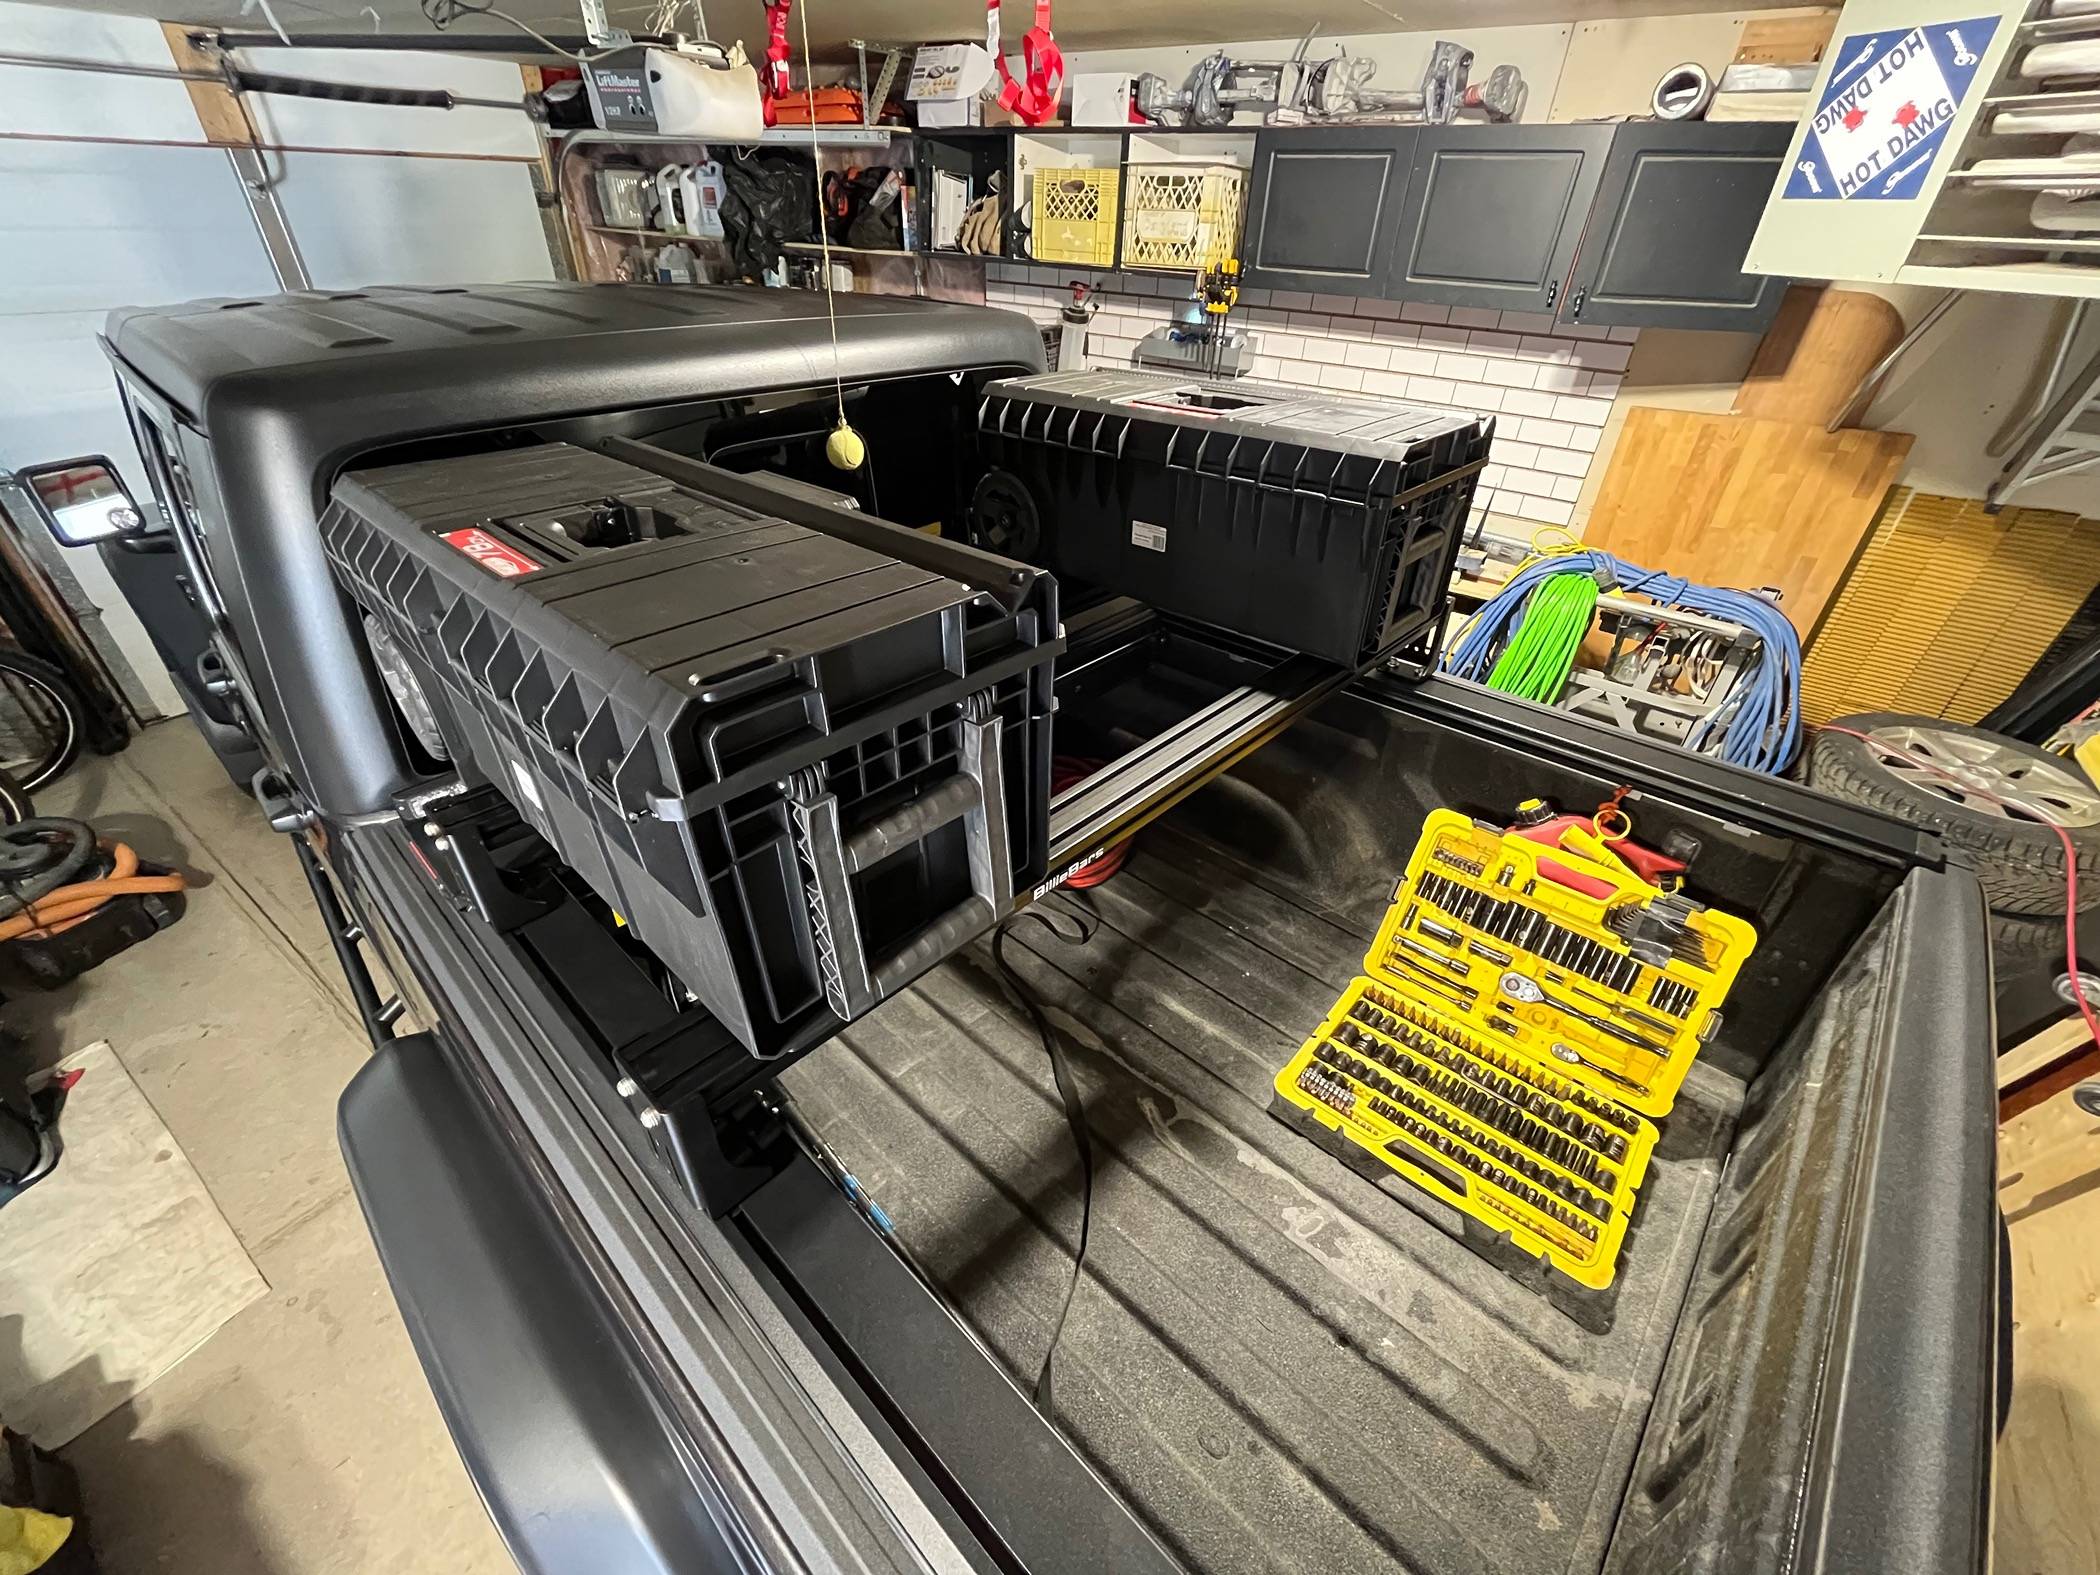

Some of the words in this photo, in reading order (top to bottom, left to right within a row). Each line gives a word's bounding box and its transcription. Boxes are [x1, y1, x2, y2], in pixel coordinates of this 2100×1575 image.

[596, 75, 640, 87] LiftMaster
[1878, 31, 1926, 84] HOT
[1814, 80, 1873, 135] DAWG
[1839, 150, 1884, 196] HOT
[1886, 97, 1954, 157] DAWG
[1033, 847, 1104, 901] BillieBars
